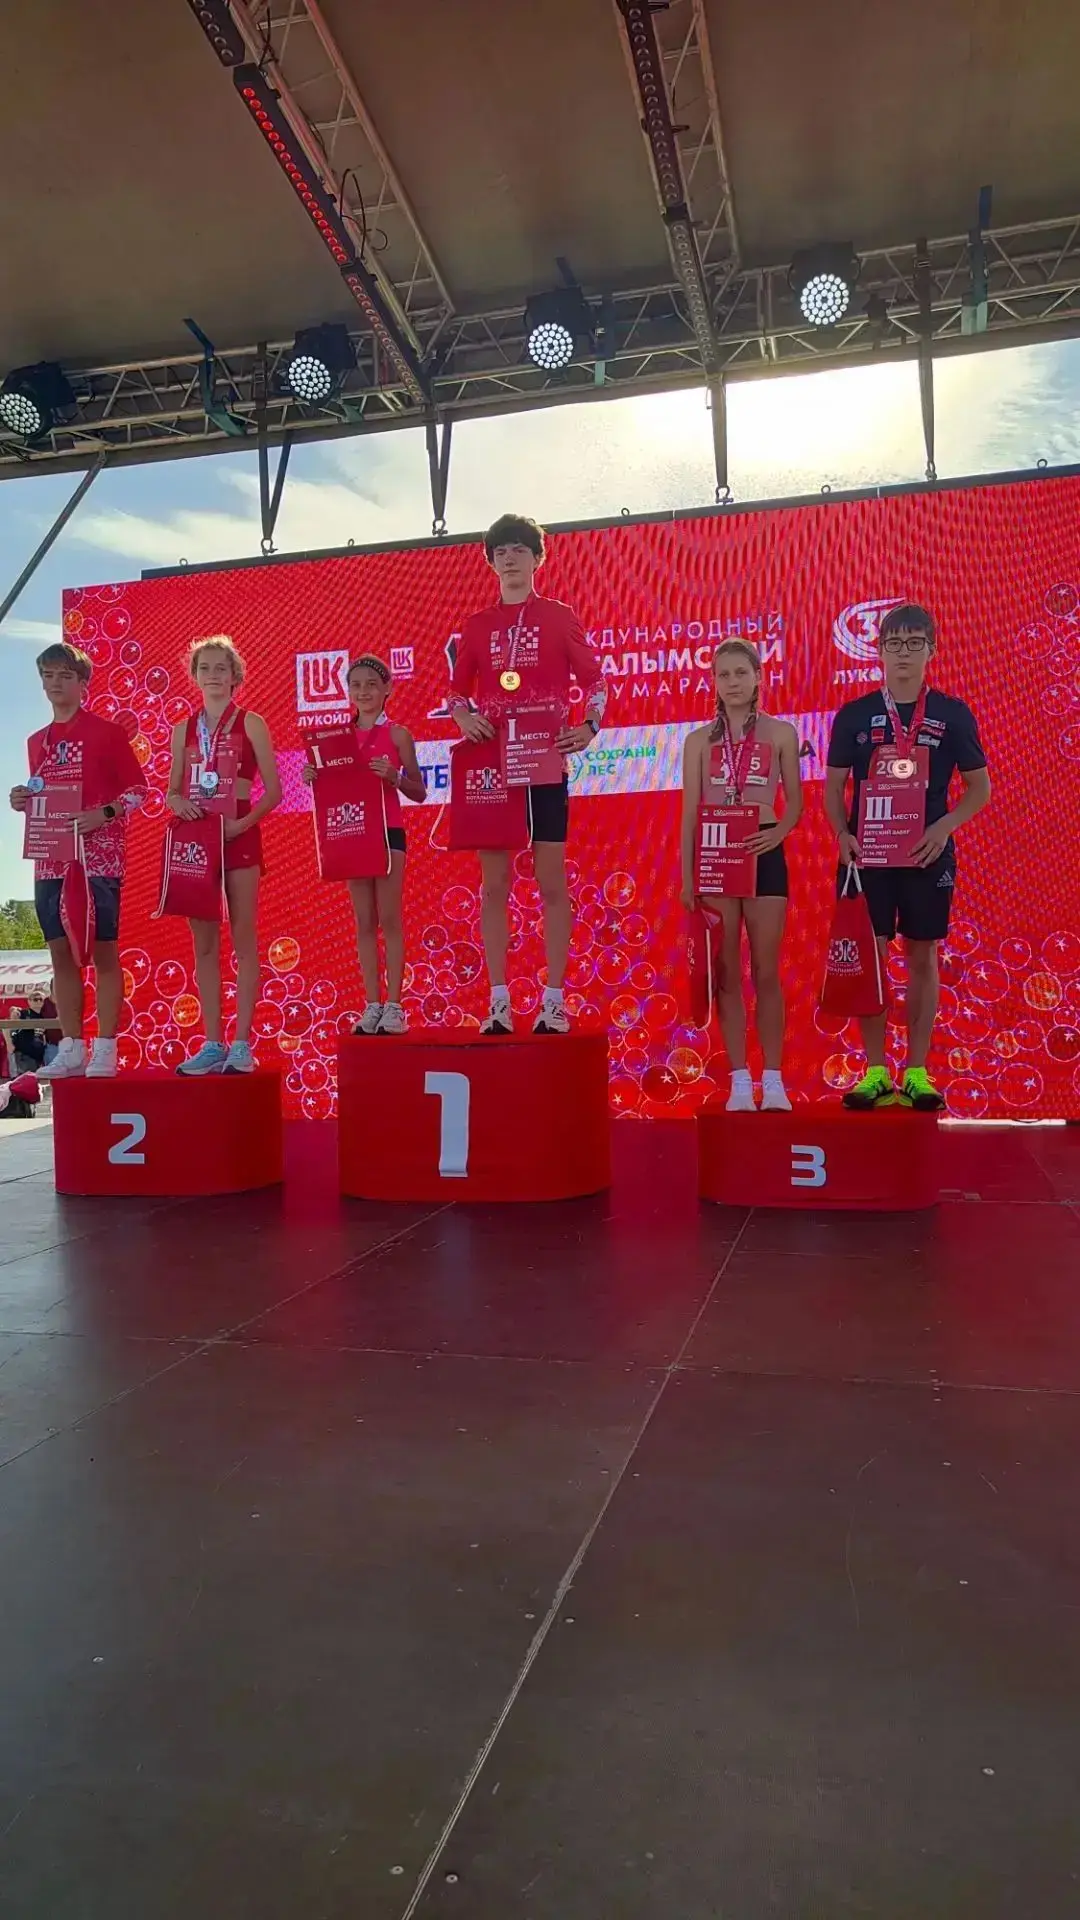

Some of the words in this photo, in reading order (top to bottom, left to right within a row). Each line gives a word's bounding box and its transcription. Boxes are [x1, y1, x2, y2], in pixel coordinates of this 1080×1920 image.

[298, 712, 351, 727] ЛУКОЙЛ
[508, 719, 516, 741] I
[520, 732, 550, 740] МЕСТО
[311, 745, 324, 769] I
[326, 756, 354, 767] МЕСТО
[585, 745, 657, 762] СОХРАНИ
[587, 764, 616, 776] ЛЕС
[30, 796, 48, 818] II
[865, 797, 893, 821] III
[701, 823, 728, 848] III
[424, 1071, 470, 1177] 1
[108, 1113, 147, 1175] 2
[791, 1144, 826, 1187] 3
